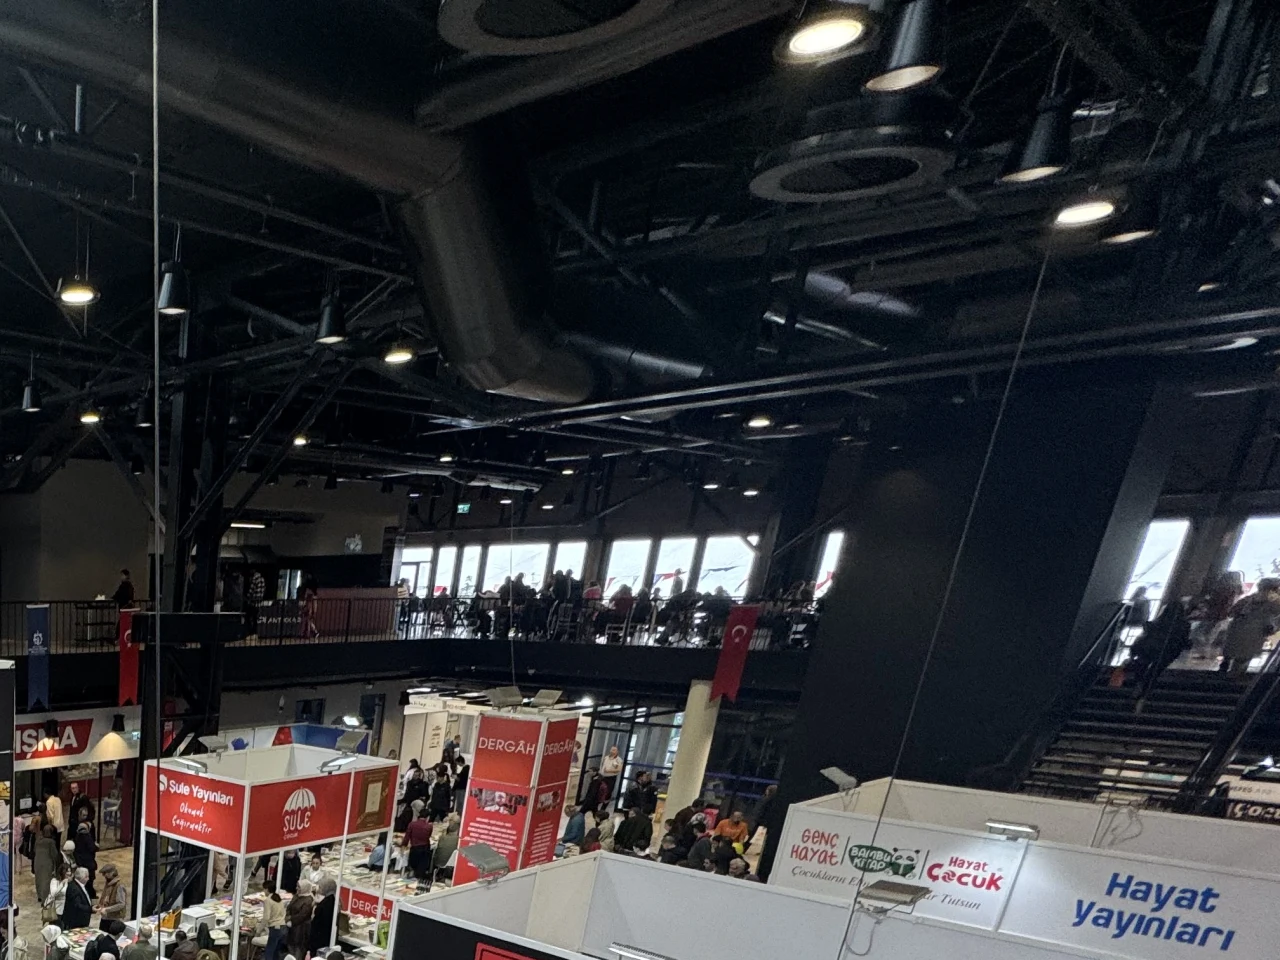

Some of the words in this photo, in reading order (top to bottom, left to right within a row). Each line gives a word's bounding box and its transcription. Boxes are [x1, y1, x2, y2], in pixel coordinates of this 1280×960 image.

[478, 737, 536, 756] DERGÂH
[543, 739, 575, 756] DERGÂH
[169, 780, 190, 795] Şule
[191, 784, 234, 806] Yayınları
[283, 810, 311, 834] ŞULE
[850, 846, 891, 861] BAMBU
[948, 855, 989, 873] Hayat
[1105, 872, 1220, 914] Hayat
[1072, 899, 1236, 951] yayınları
